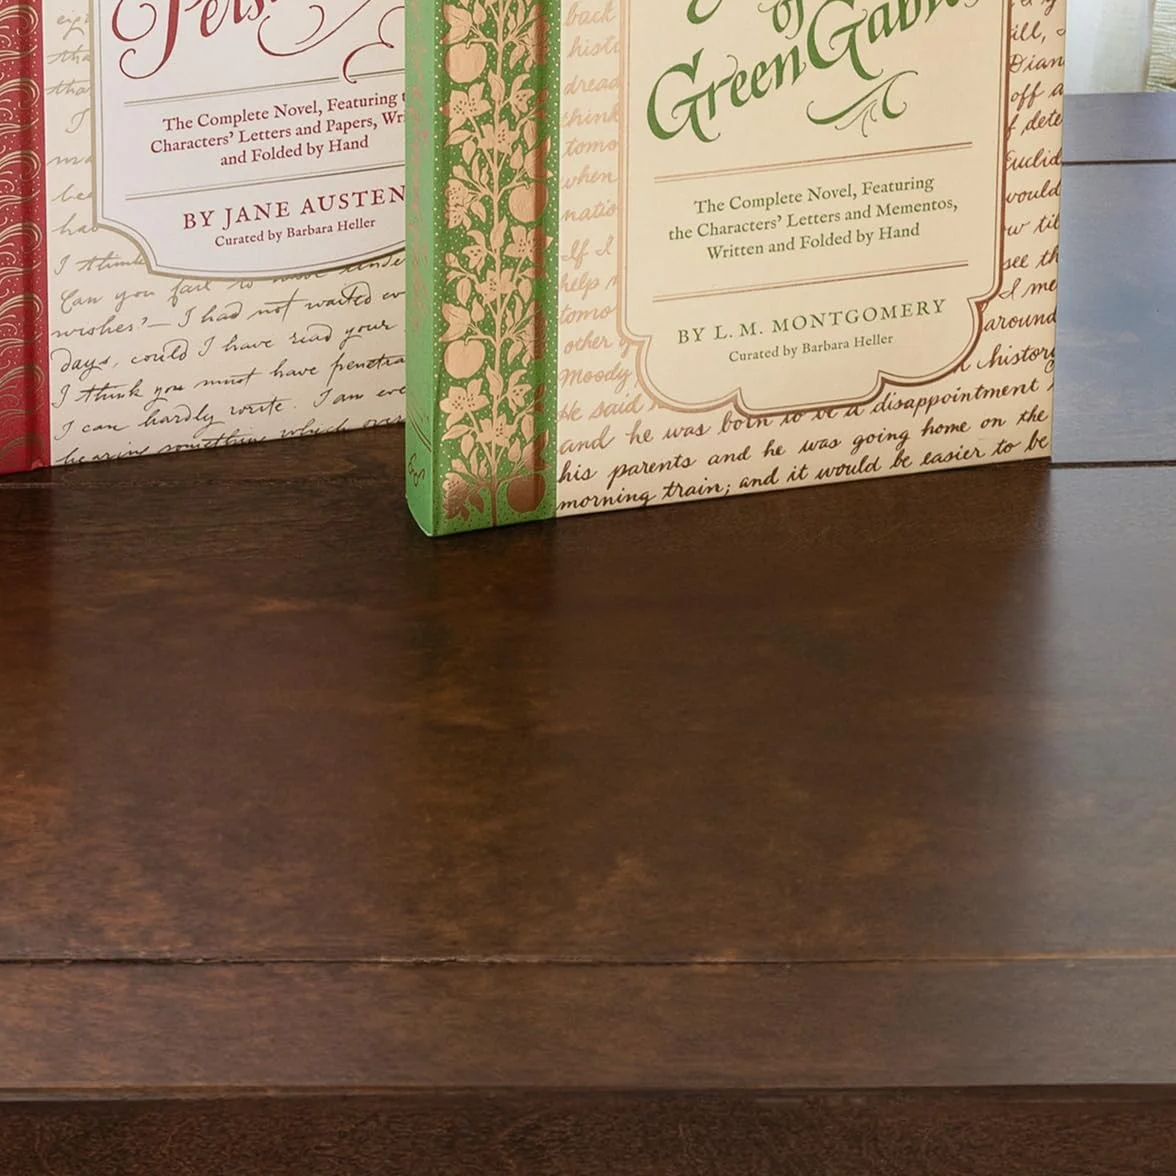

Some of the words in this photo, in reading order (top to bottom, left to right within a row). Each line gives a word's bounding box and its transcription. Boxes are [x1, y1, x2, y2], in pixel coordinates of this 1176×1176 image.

[162, 117, 194, 132] The
[197, 109, 270, 129] Complete
[273, 102, 324, 118] Novel,
[327, 93, 398, 112] Featuring
[647, 45, 806, 143] Green
[239, 126, 292, 144] Letters
[295, 121, 322, 136] and
[326, 117, 378, 134] Papers,
[220, 151, 247, 166] and
[251, 144, 302, 162] Folded
[306, 140, 324, 158] by
[329, 135, 370, 152] Hand
[183, 210, 215, 230] BY
[222, 201, 290, 230] JANE
[300, 184, 406, 215] AUSTEN
[693, 199, 725, 215] The
[729, 190, 803, 212] Complete
[807, 184, 858, 202] Novel,
[862, 177, 936, 196] Featuring
[214, 231, 264, 248] Curated
[268, 229, 283, 243] by
[286, 224, 334, 238] Barbara
[337, 218, 376, 232] Heller
[668, 225, 693, 241] the
[787, 210, 842, 228] Letters
[845, 206, 872, 222] and
[876, 198, 958, 217] Mementos,
[707, 242, 764, 260] Written
[768, 237, 796, 253] and
[800, 231, 852, 249] Folded
[856, 228, 874, 246] by
[878, 223, 921, 240] Hand
[677, 328, 705, 345] BY
[713, 325, 734, 340] L.
[740, 321, 764, 337] M.
[772, 298, 948, 334] MONTGOMERY
[729, 347, 780, 363] Curated
[783, 345, 798, 359] by
[802, 338, 850, 355] Barbara
[854, 334, 894, 348] Heller
[54, 420, 76, 441] I
[82, 423, 130, 434] can
[138, 403, 226, 439] hardly
[313, 387, 334, 409] I
[332, 393, 364, 406] am
[872, 379, 1040, 418] disappointment
[557, 459, 598, 484] his
[607, 454, 696, 491] parents
[707, 445, 752, 466] and
[762, 439, 786, 458] he
[798, 438, 842, 455] was
[852, 428, 912, 455] going
[921, 416, 972, 438] home
[980, 417, 1007, 430] on
[1016, 404, 1050, 426] the
[663, 477, 732, 498] train;
[739, 466, 780, 489] and
[786, 464, 810, 483] it
[814, 453, 884, 481] would
[890, 448, 914, 470] be
[920, 445, 986, 466] easier
[992, 439, 1022, 456] to
[1024, 429, 1050, 452] be
